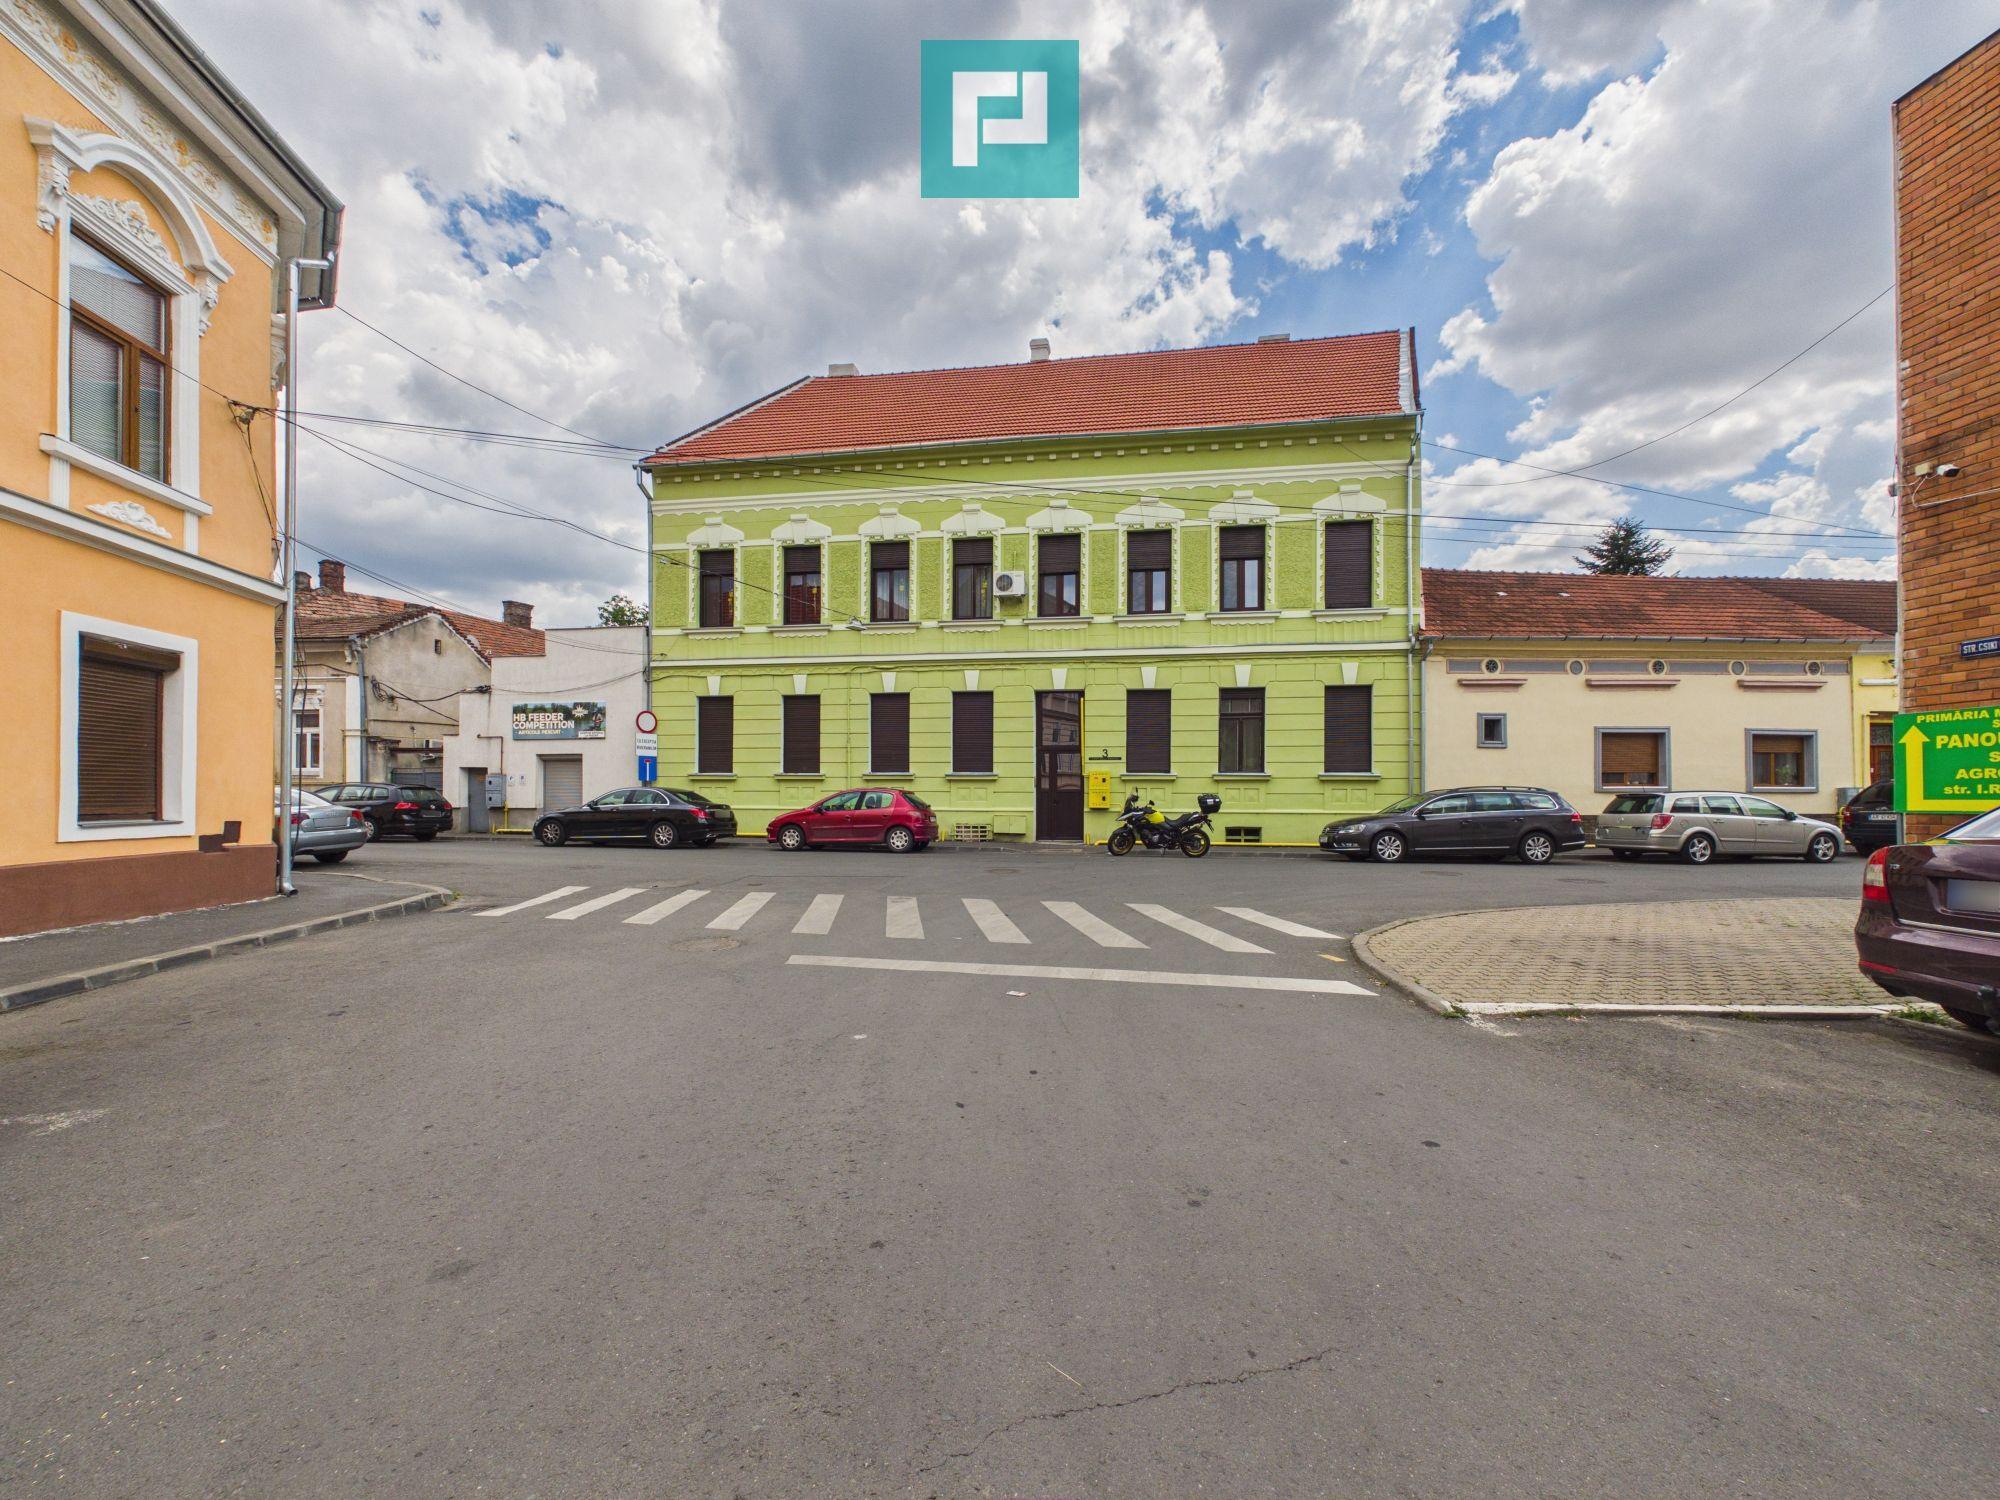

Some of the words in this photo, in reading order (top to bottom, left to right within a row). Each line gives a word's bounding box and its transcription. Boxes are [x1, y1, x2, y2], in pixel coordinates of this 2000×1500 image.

[1978, 641, 1998, 651] CSIKI
[513, 713, 527, 722] HB
[528, 712, 564, 721] FEEDER
[1916, 709, 1990, 723] PRIMĂRIA
[512, 720, 575, 730] COMPETITION
[1936, 732, 2000, 749] PANO
[1102, 749, 1109, 758] 3
[1955, 768, 2000, 779] AGR
[1943, 784, 1971, 795] str.
